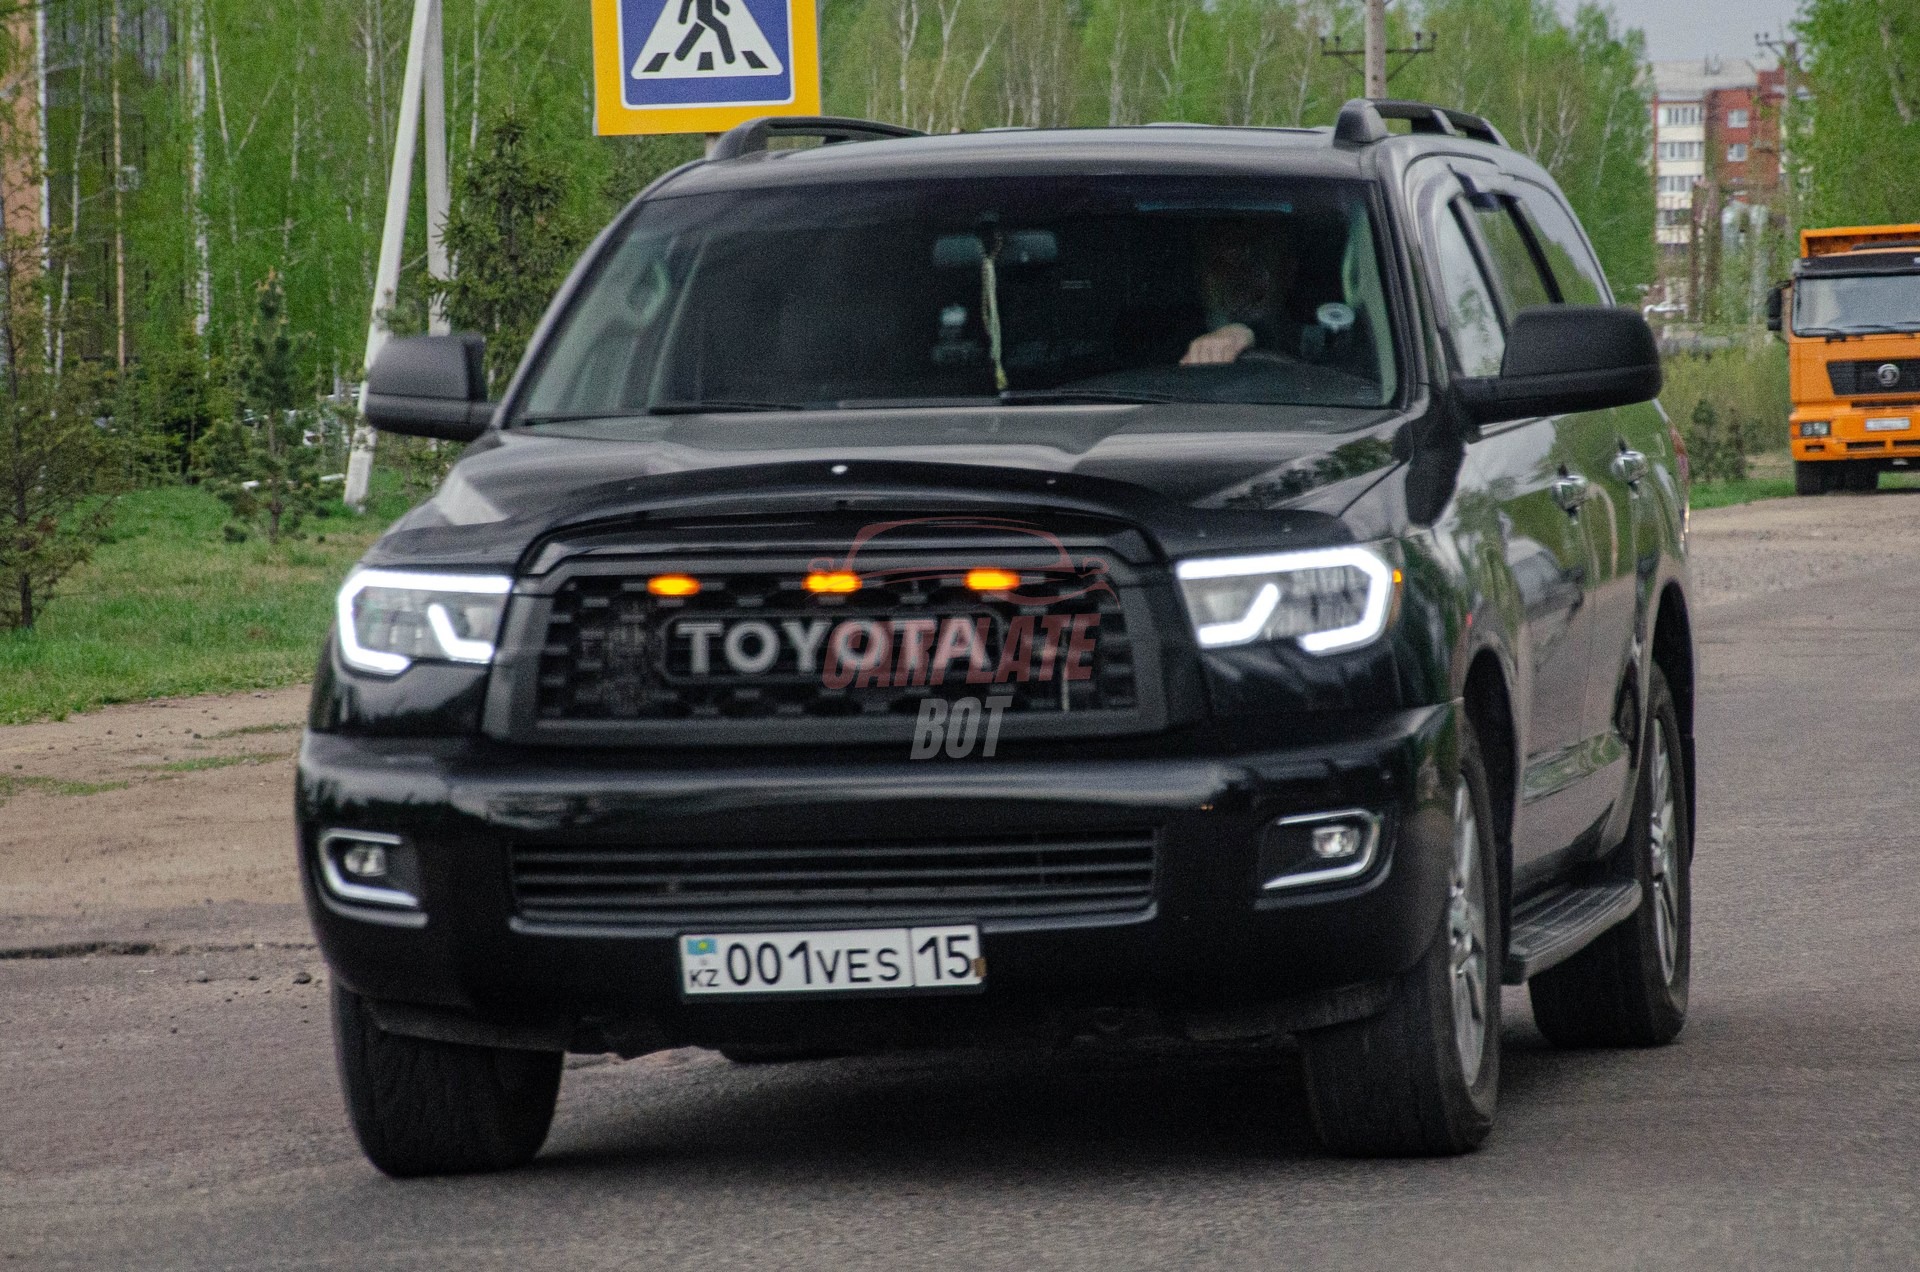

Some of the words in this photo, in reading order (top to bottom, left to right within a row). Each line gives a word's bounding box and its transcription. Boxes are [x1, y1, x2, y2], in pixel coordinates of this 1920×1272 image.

[675, 618, 991, 674] TOYOTA
[689, 968, 720, 988] KZ
[726, 940, 901, 985] 001VES
[918, 934, 972, 980] 15
